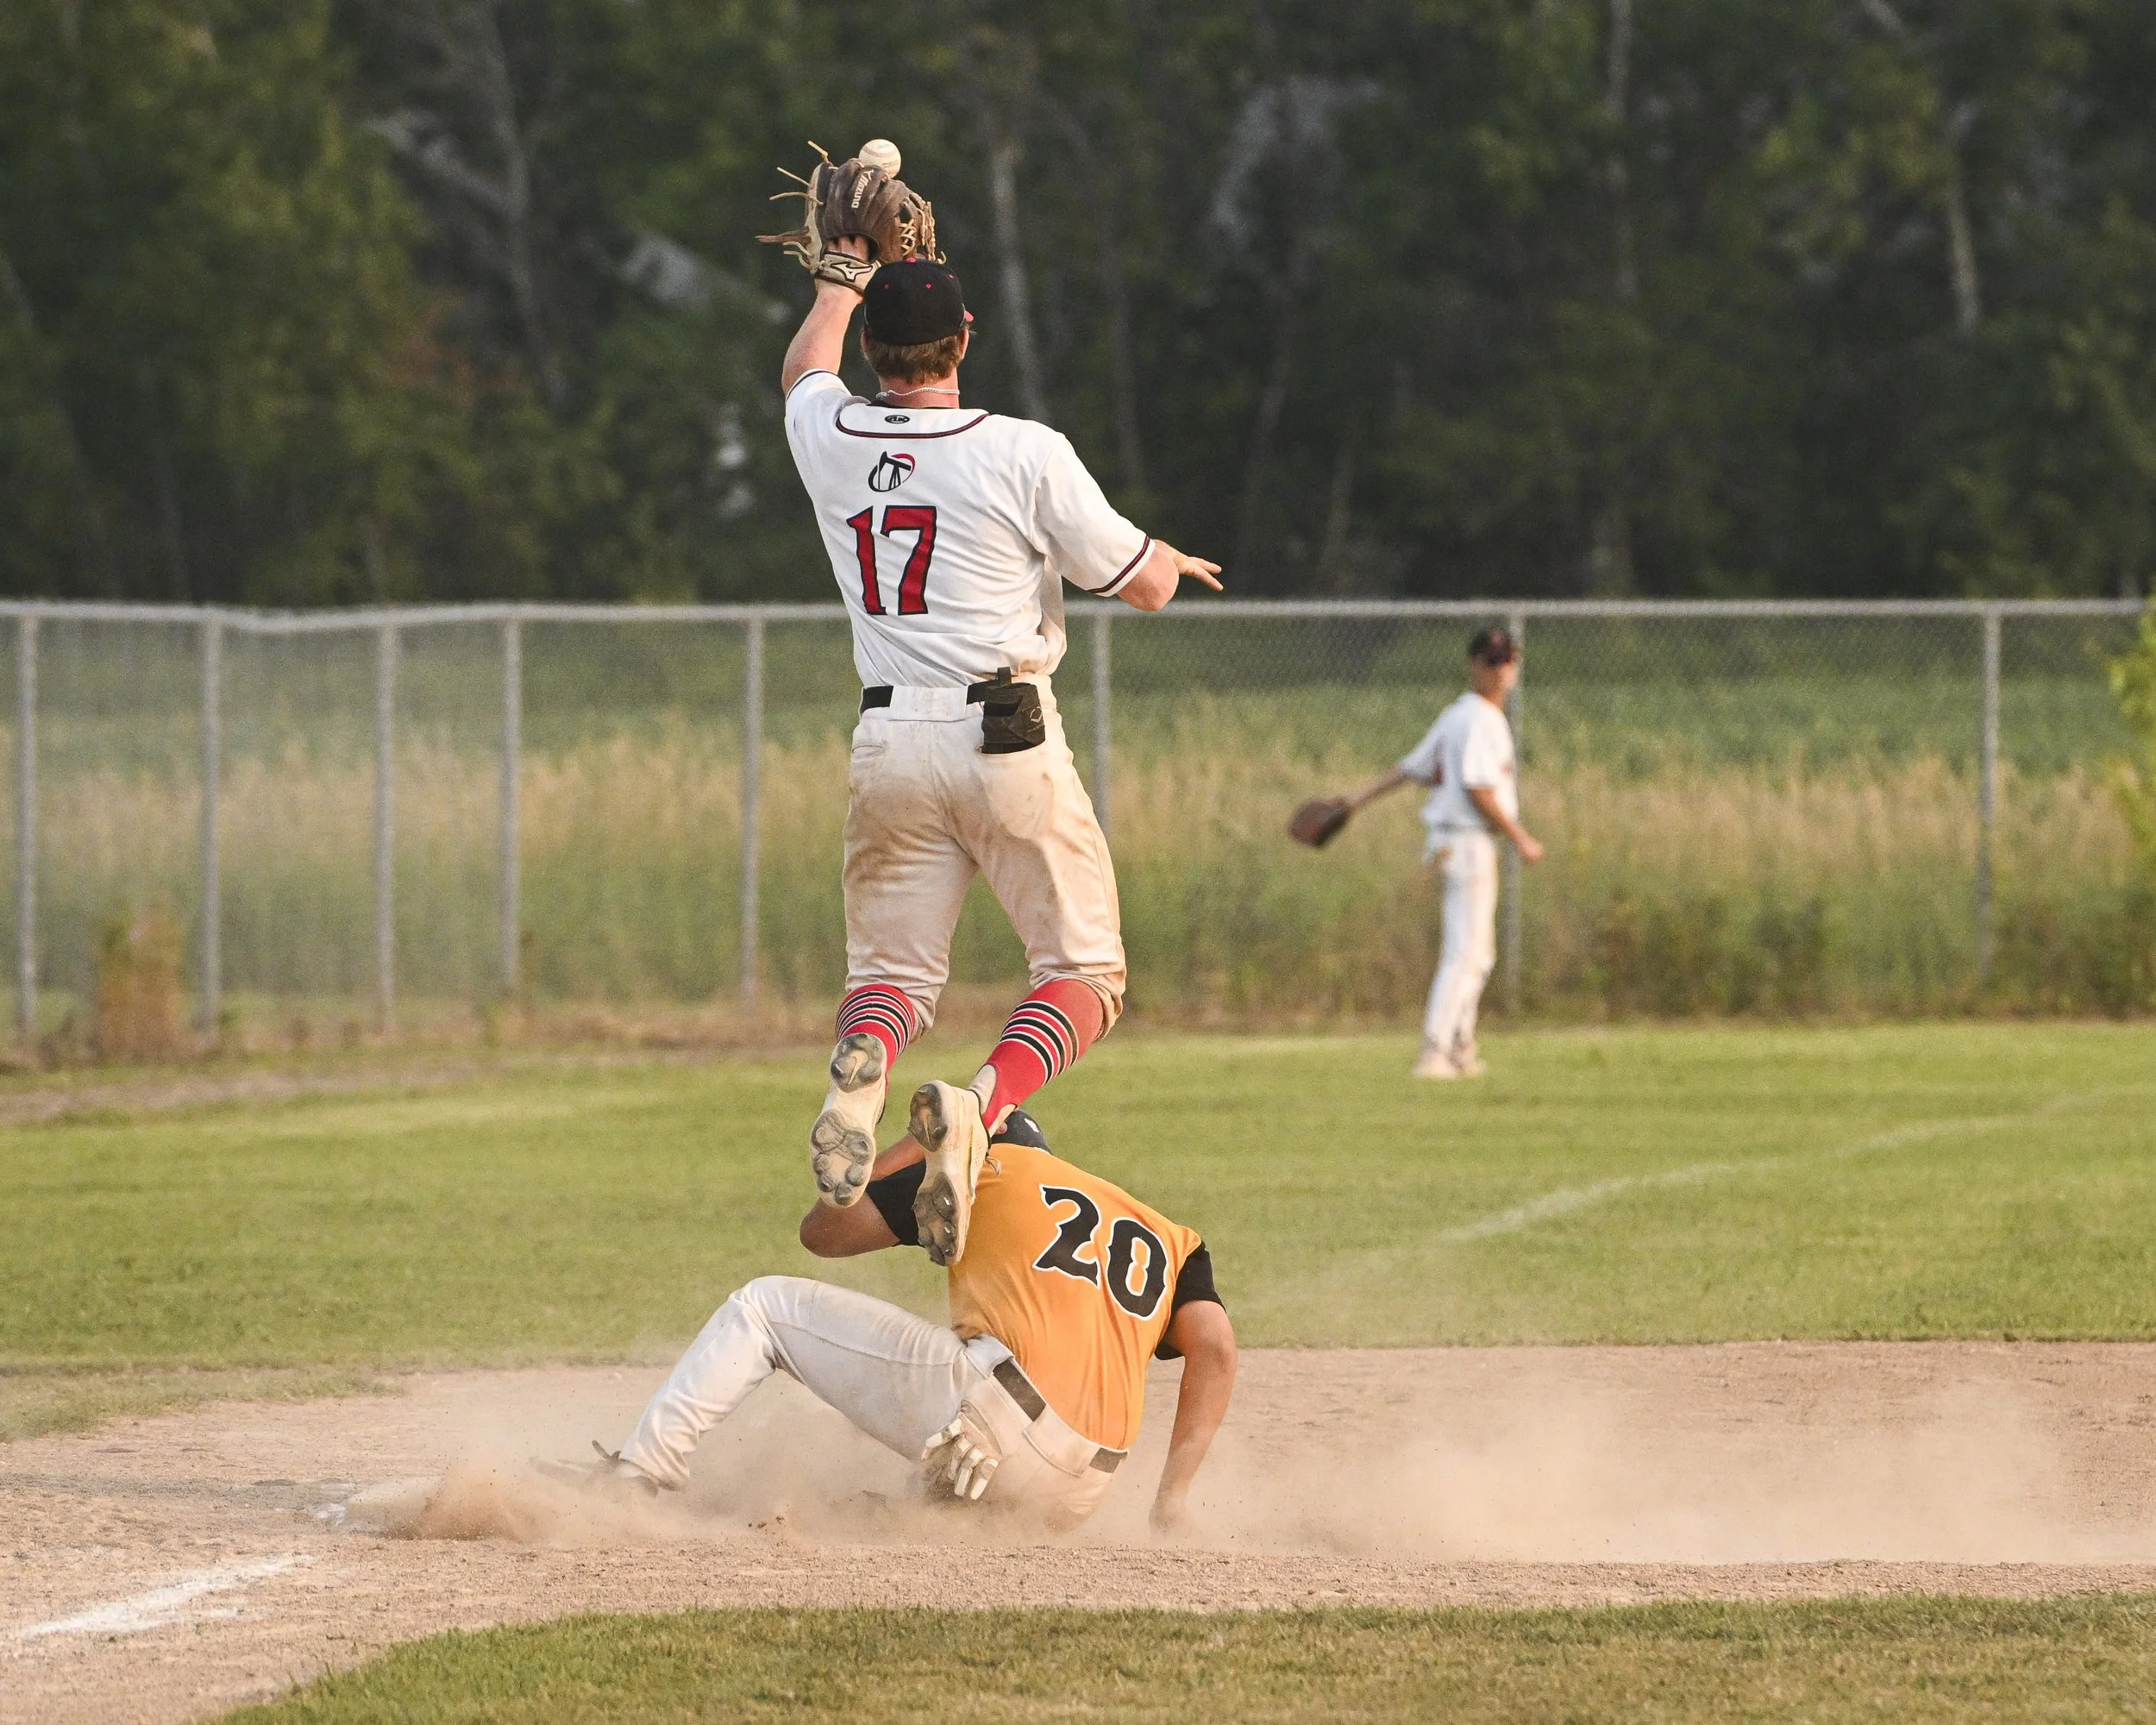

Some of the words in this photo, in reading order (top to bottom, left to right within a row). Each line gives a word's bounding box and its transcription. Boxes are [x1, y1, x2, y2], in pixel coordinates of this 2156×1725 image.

[851, 175, 868, 209] MIZUNO
[846, 505, 937, 616] 17
[1033, 1183, 1168, 1320] 20
